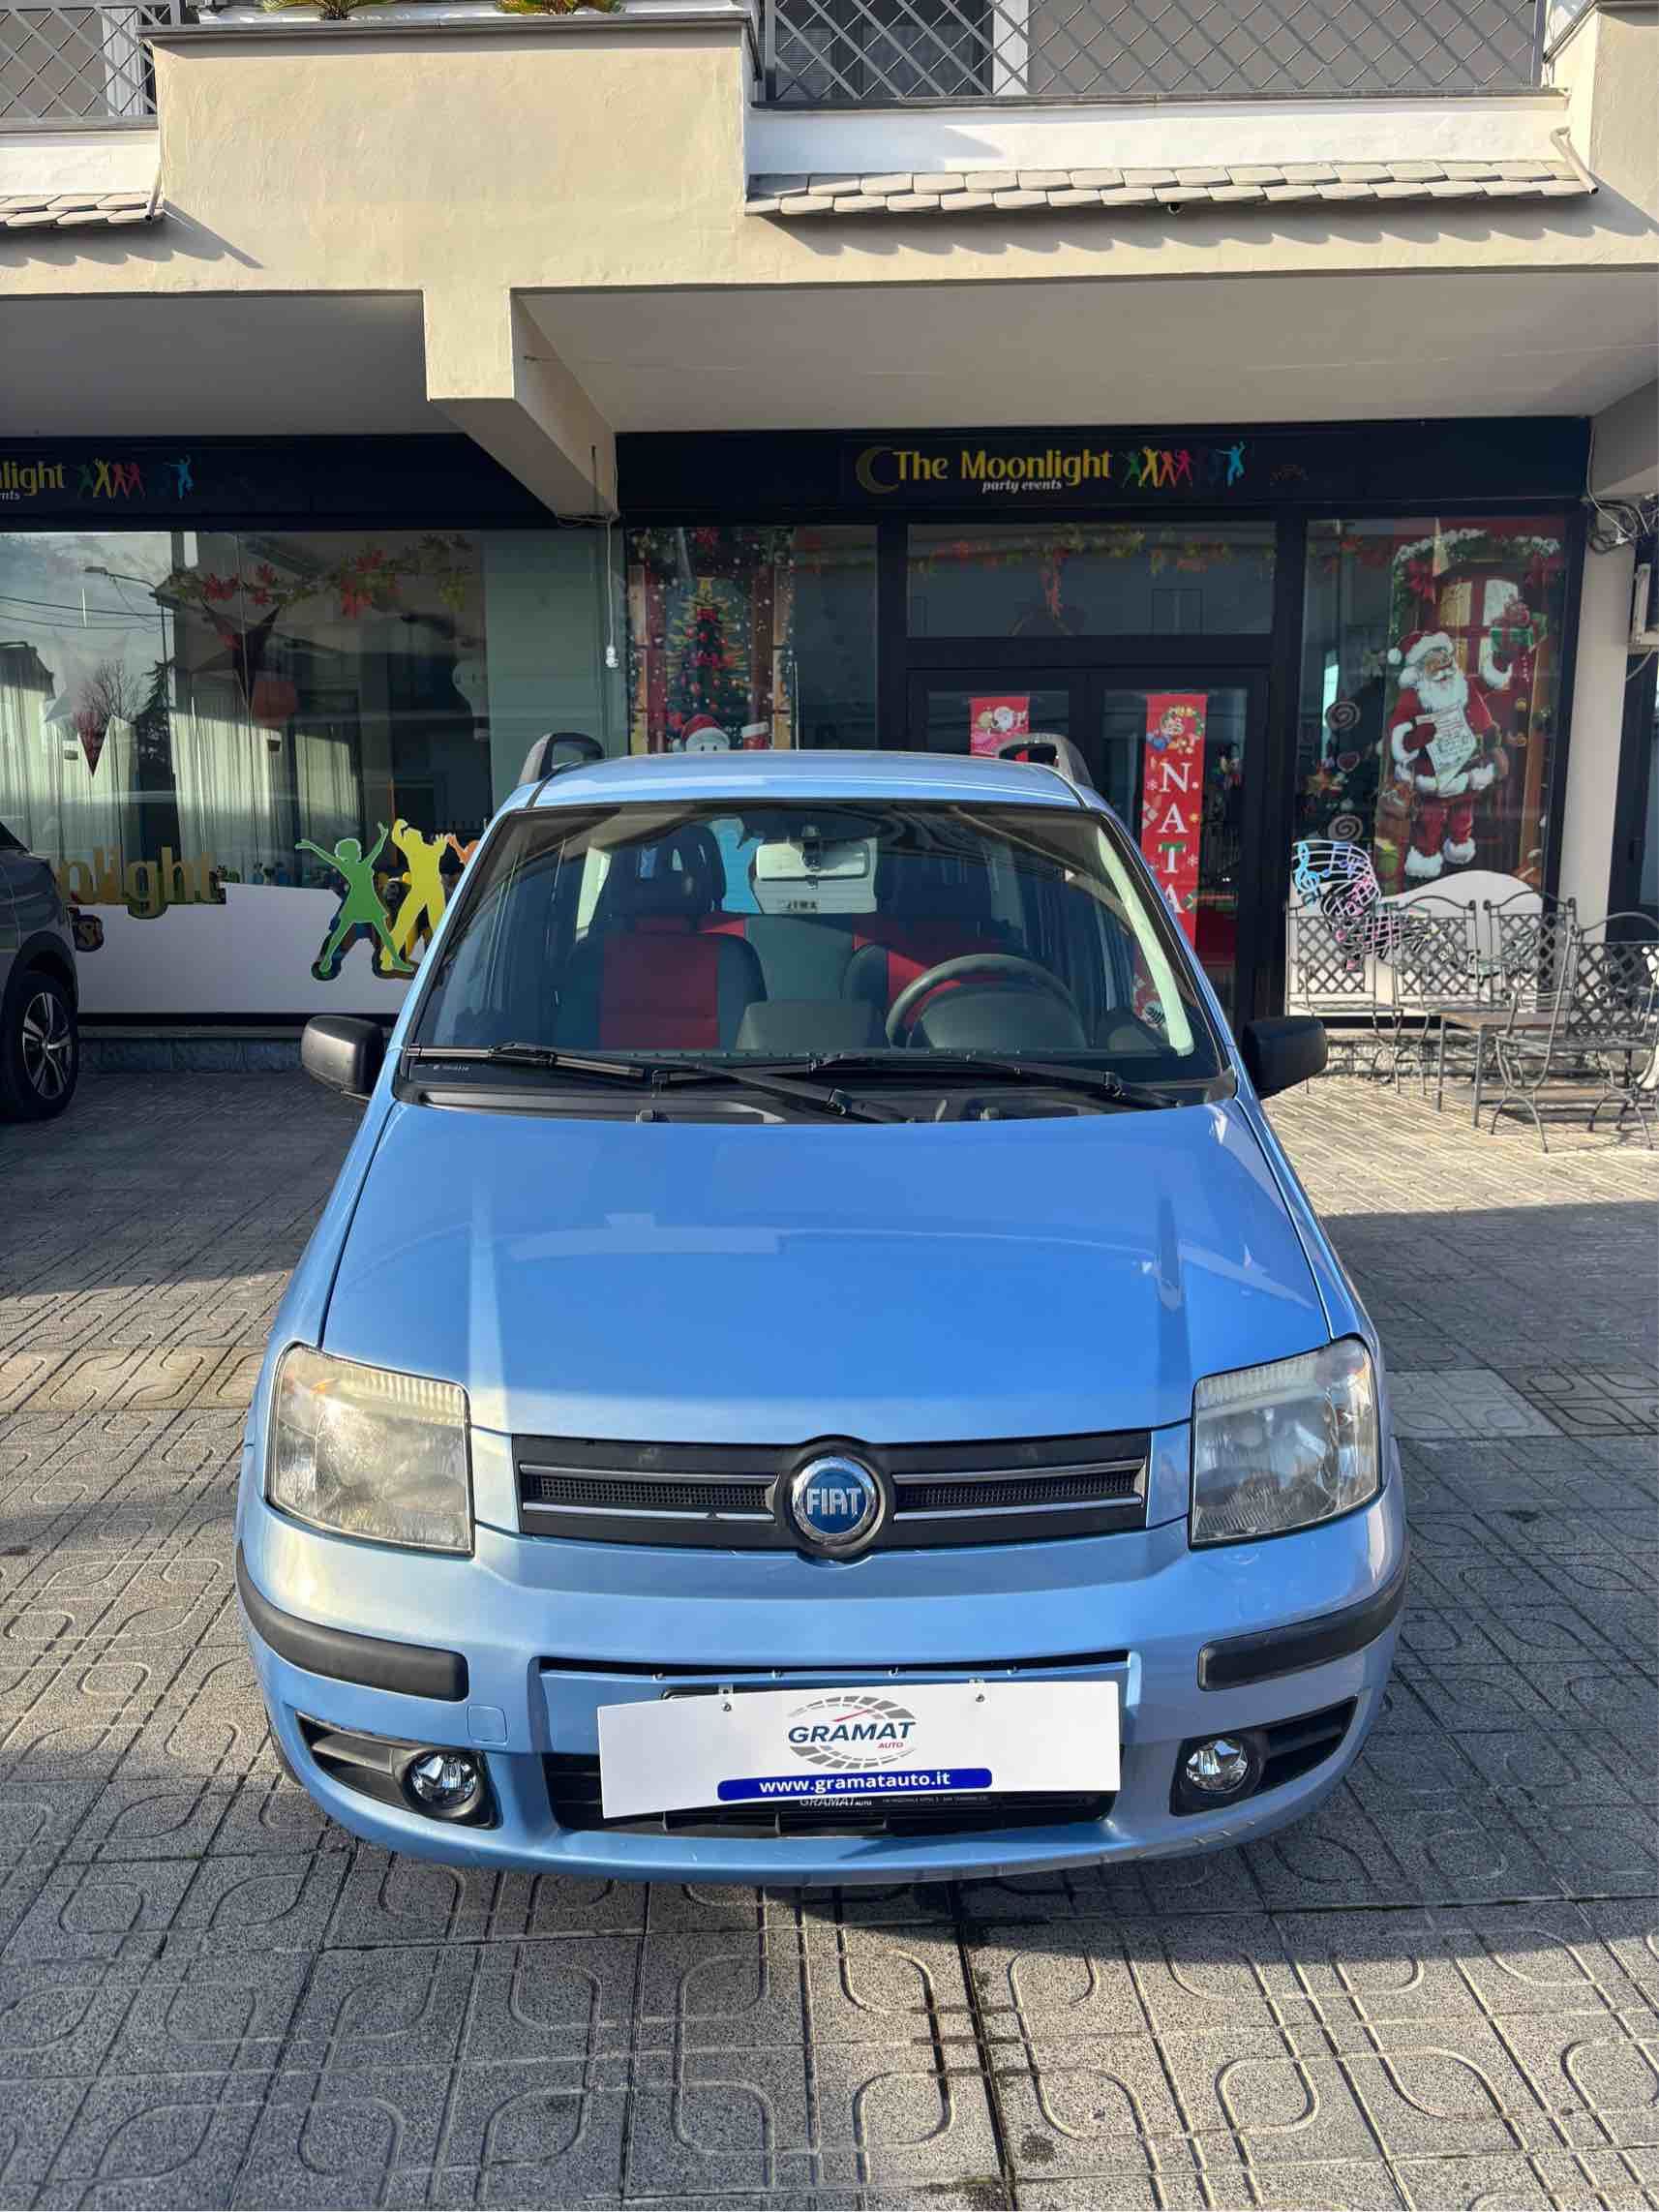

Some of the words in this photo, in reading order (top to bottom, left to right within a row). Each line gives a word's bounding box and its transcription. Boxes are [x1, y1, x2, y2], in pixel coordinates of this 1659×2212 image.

[0, 460, 66, 497] light
[892, 450, 949, 480] The
[960, 449, 1113, 485] Moonlight
[981, 478, 1017, 493] party
[1021, 479, 1062, 491] events
[806, 1487, 861, 1516] FIAT
[788, 1722, 917, 1743] GRAMAT
[759, 1771, 950, 1794] www.gramatauto.it
